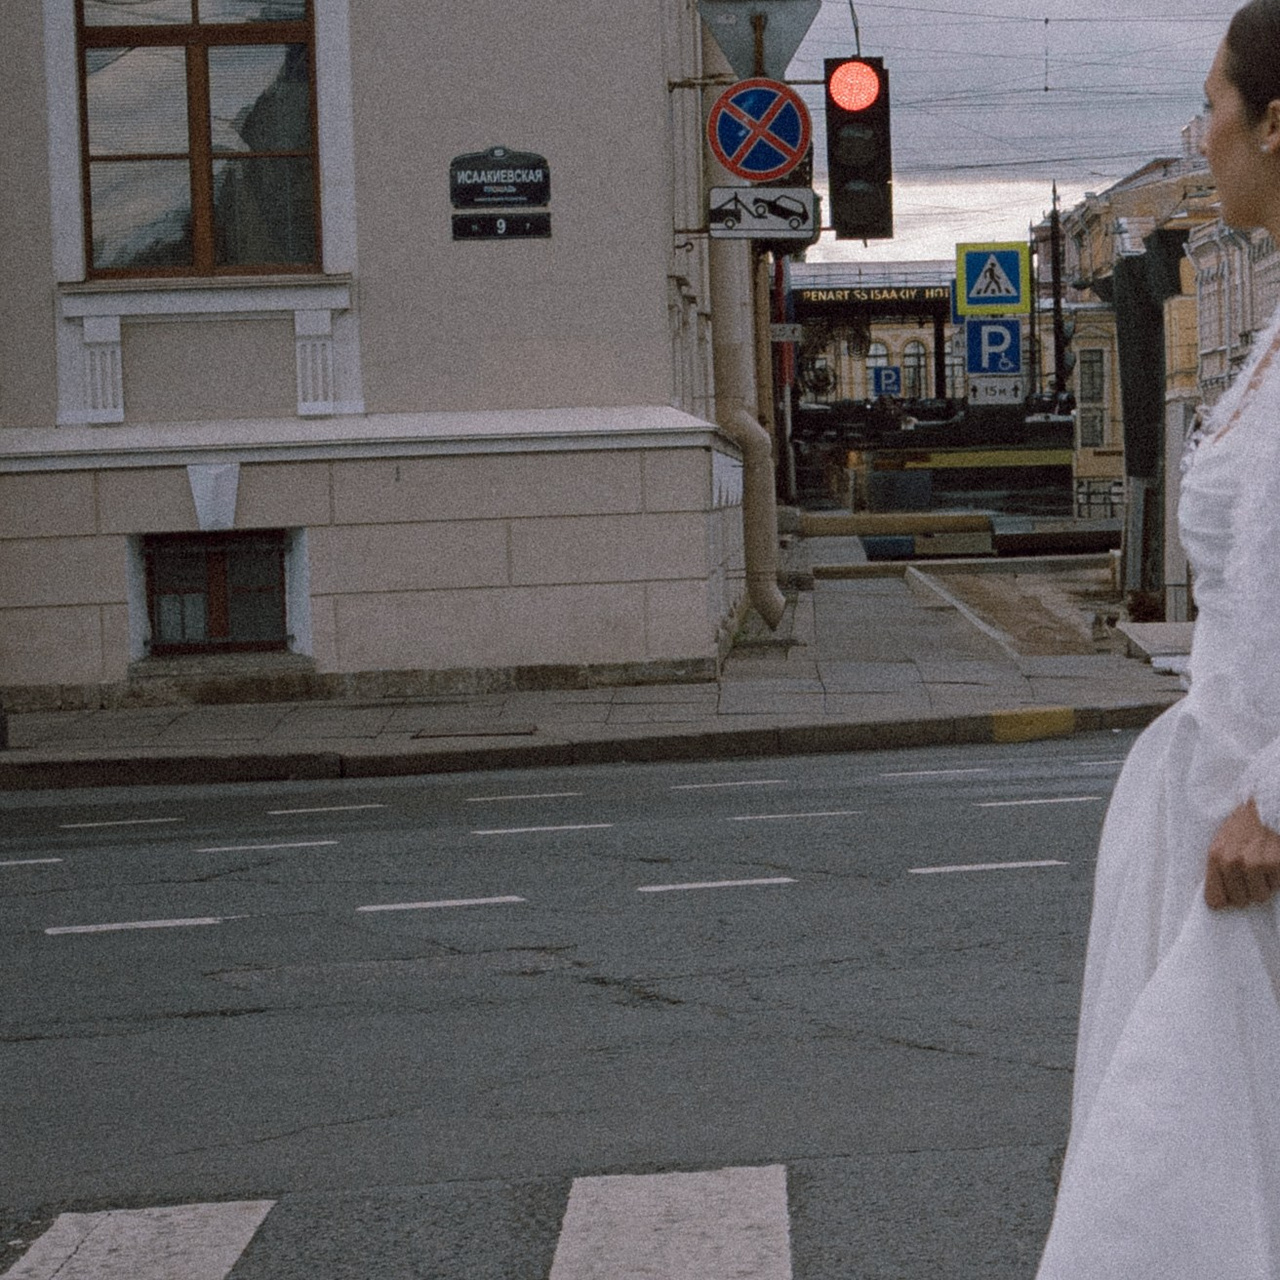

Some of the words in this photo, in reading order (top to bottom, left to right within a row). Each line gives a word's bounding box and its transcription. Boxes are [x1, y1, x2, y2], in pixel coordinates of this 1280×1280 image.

[457, 169, 543, 184] ИСААКИЕВСКАЯ
[496, 219, 507, 234] 9
[981, 325, 1012, 369] P
[881, 369, 897, 391] P
